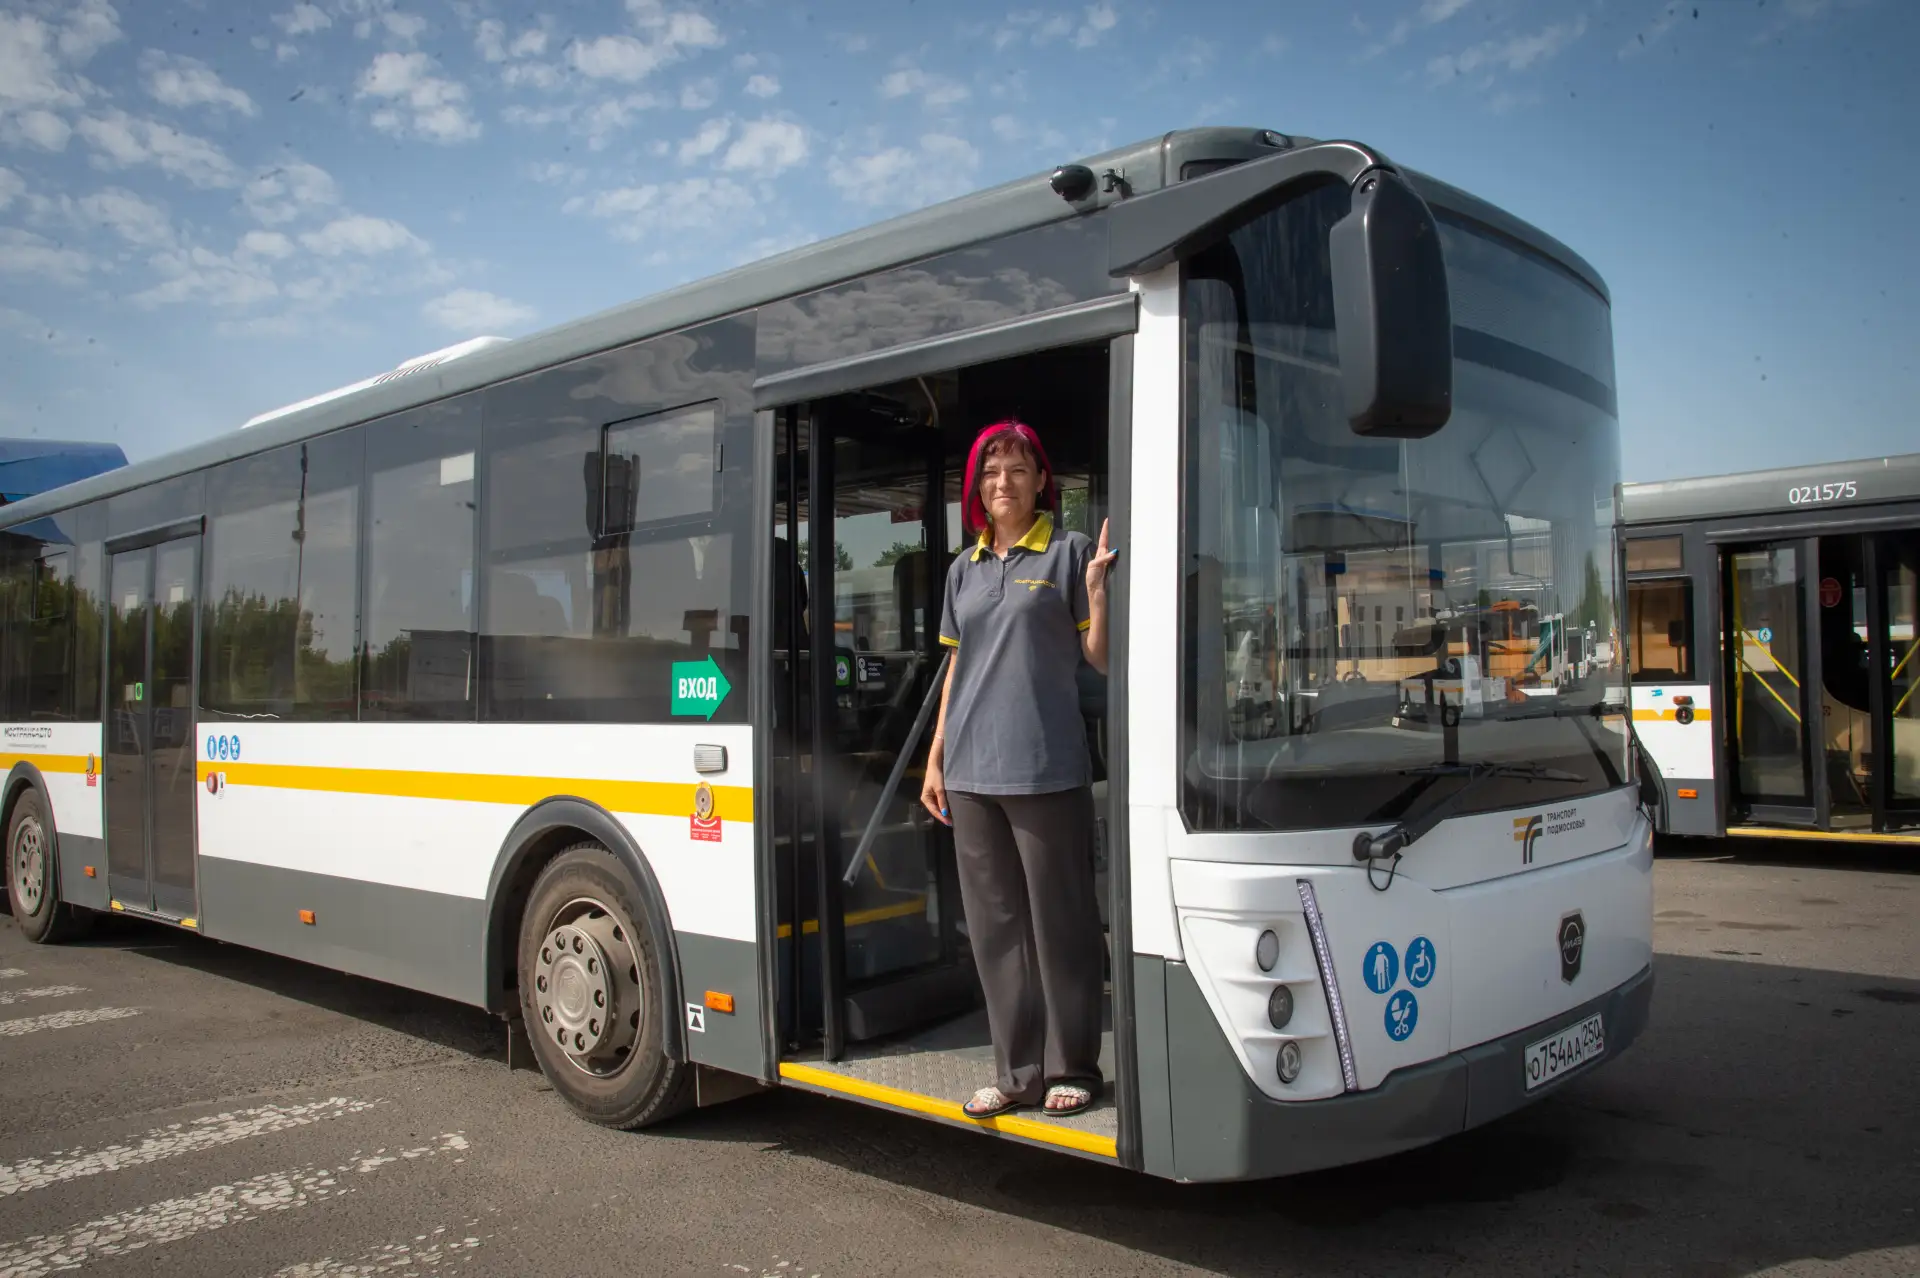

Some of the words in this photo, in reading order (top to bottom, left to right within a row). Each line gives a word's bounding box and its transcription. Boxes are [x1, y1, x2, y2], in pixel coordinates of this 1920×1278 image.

[1788, 481, 1857, 504] 021575
[678, 676, 718, 700] ВХОД
[1546, 808, 1577, 822] ТРАНСПОРТ
[1546, 819, 1586, 835] ПОДМОСКОВЬЯ
[1582, 1018, 1600, 1047] 250
